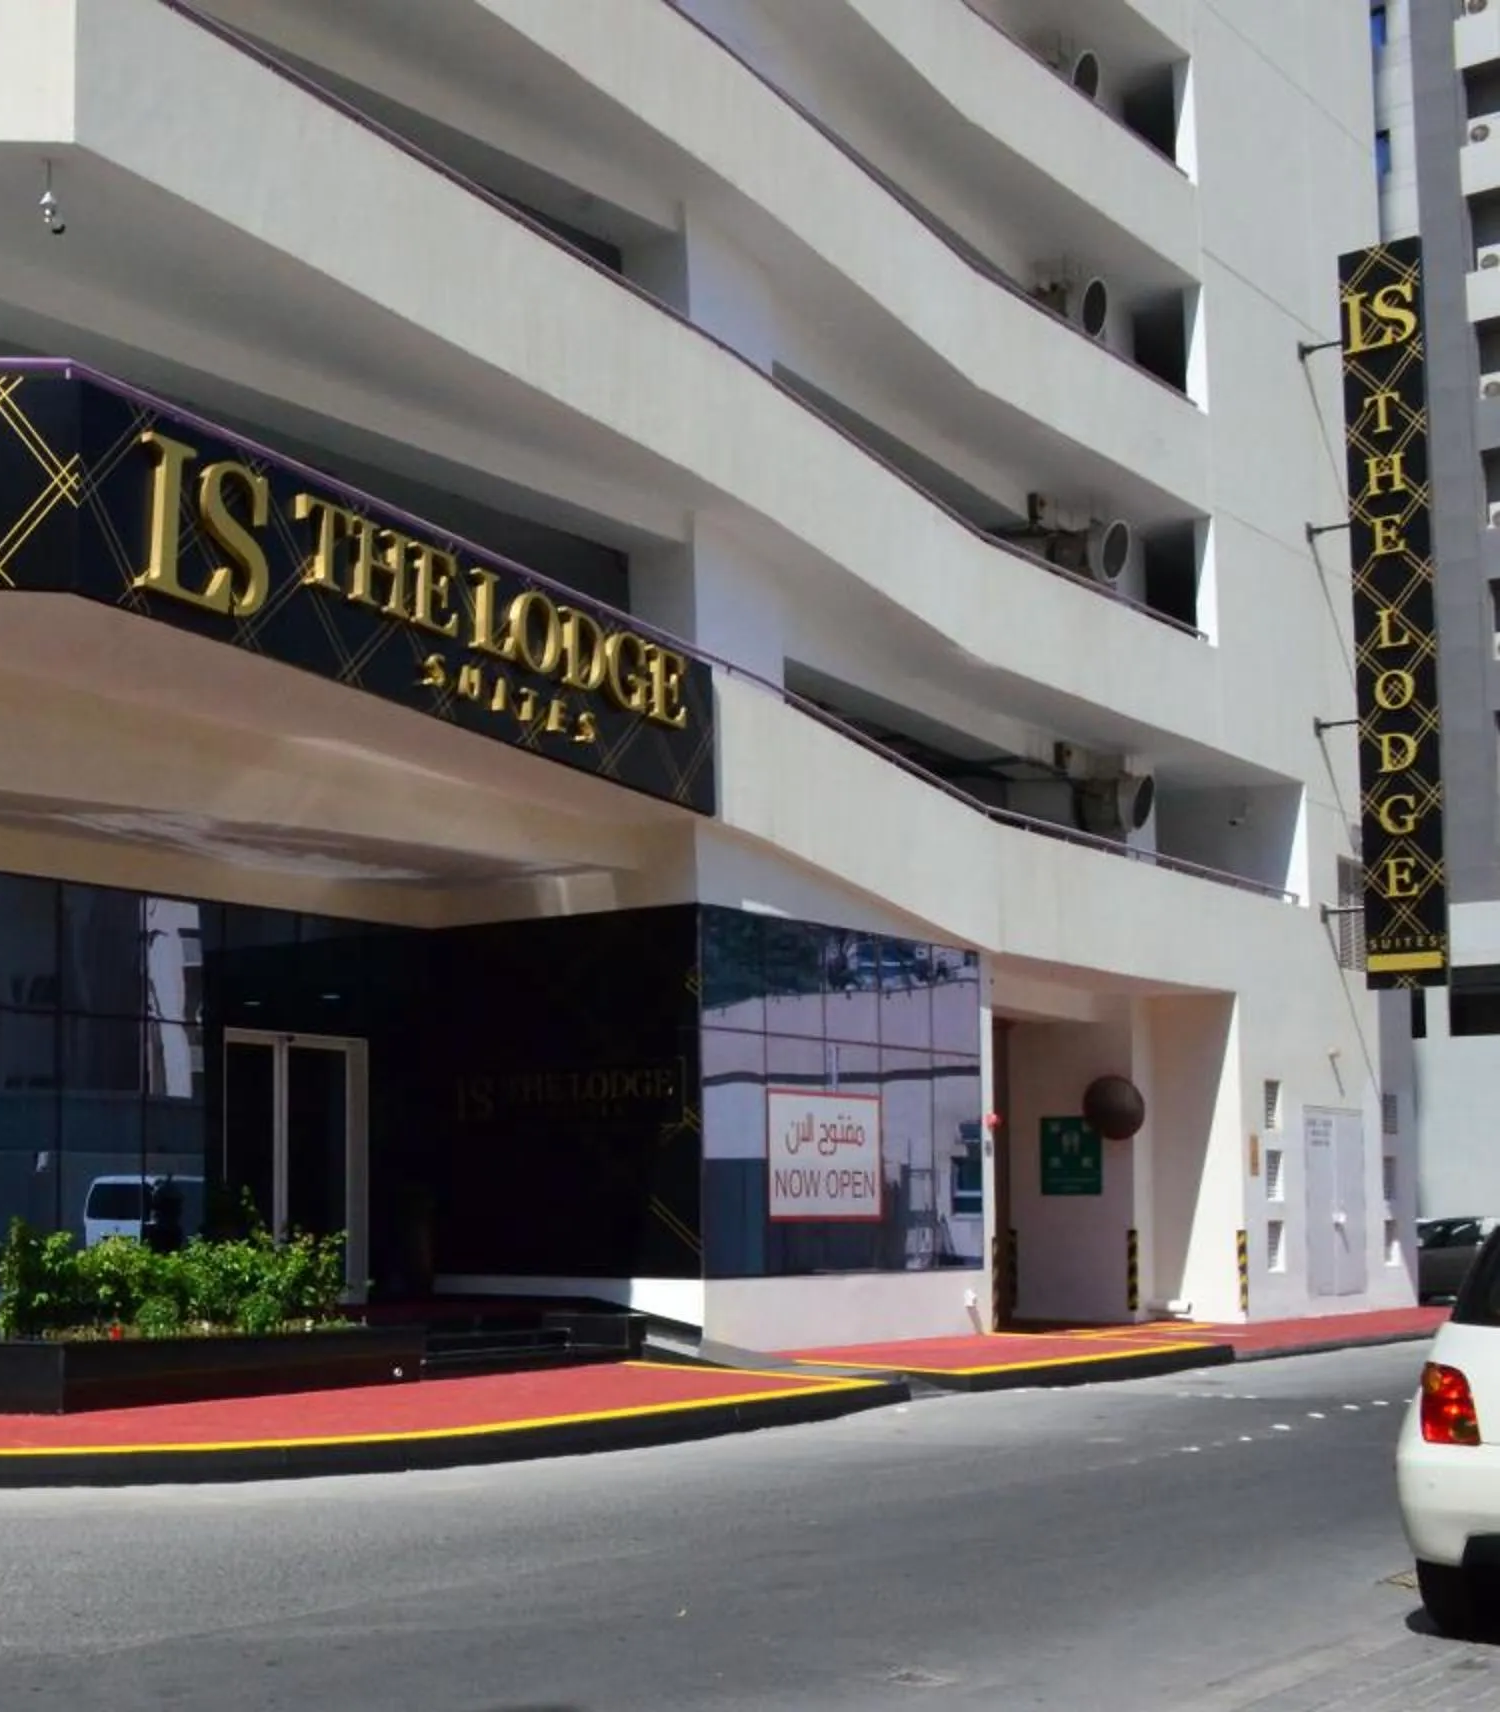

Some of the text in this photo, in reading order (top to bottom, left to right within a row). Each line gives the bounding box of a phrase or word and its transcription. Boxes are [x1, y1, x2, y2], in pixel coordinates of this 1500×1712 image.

[1342, 282, 1417, 356] LS
[134, 430, 687, 729] LS THE LODGE
[1363, 391, 1419, 898] THE LODGE
[415, 653, 597, 744] SUITES
[817, 1113, 865, 1156] مفتوح
[774, 1168, 876, 1199] NOW OPEN
